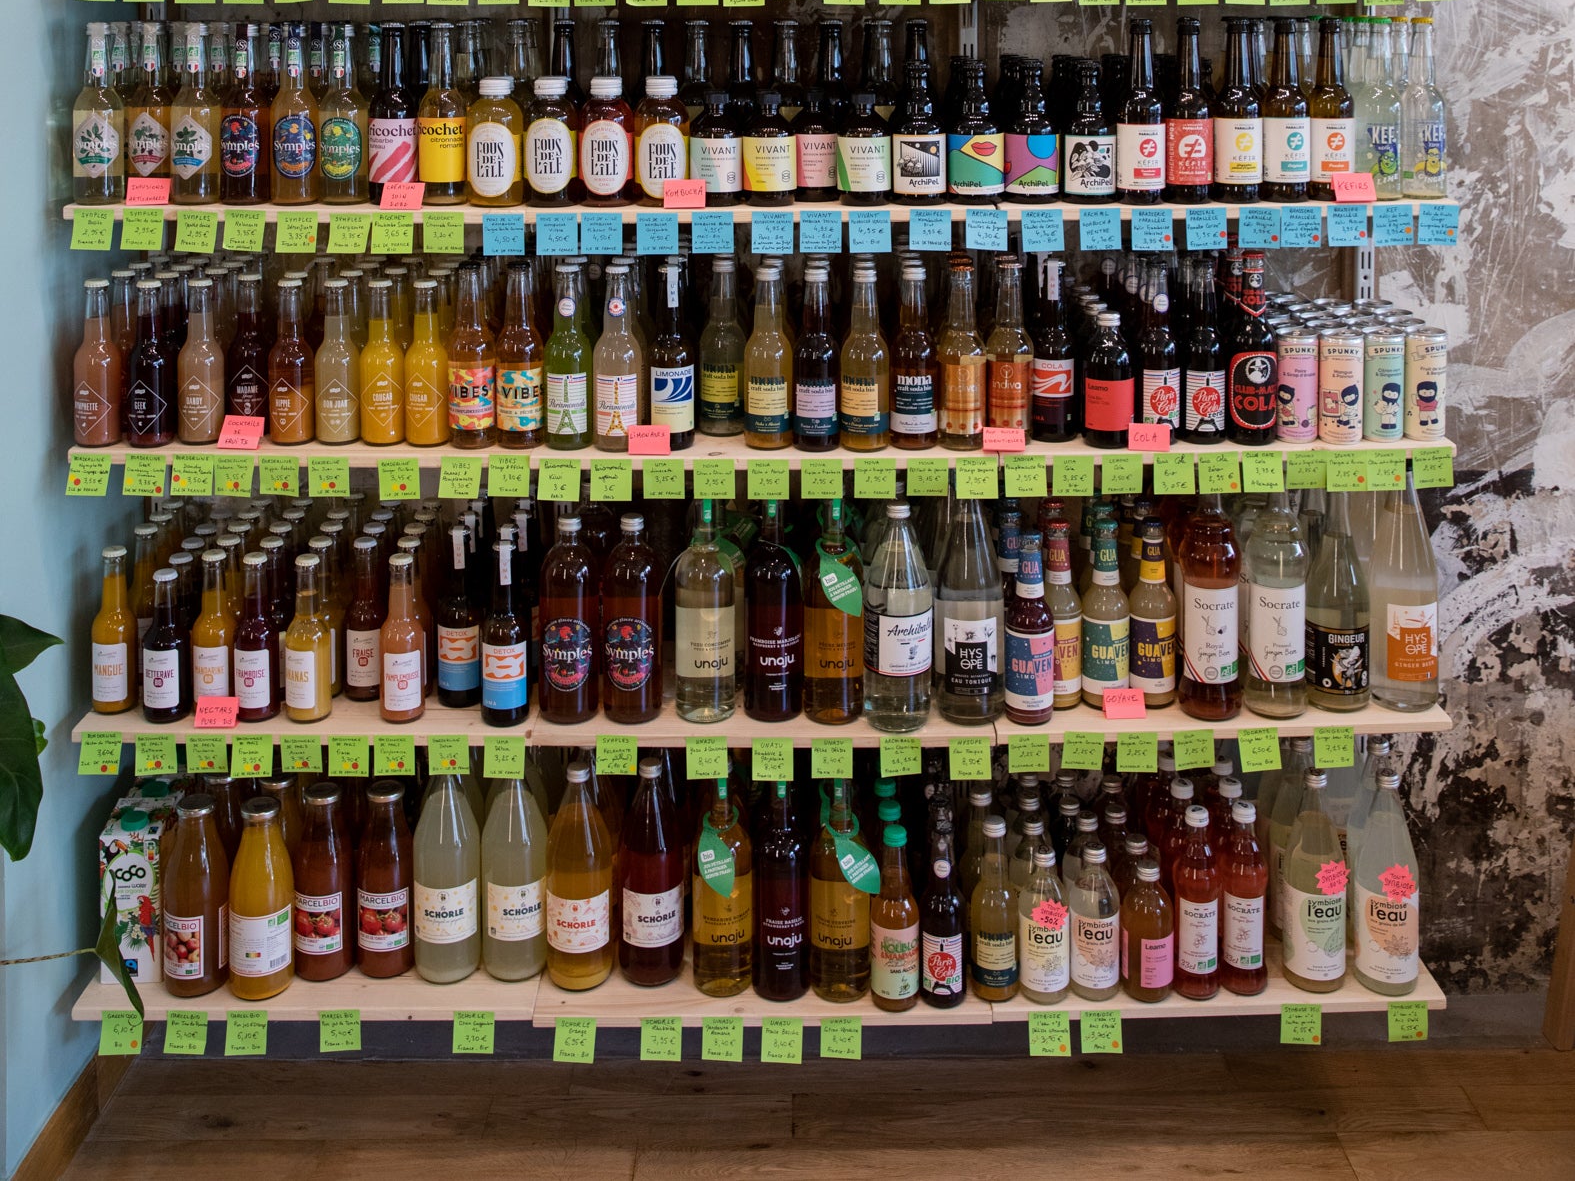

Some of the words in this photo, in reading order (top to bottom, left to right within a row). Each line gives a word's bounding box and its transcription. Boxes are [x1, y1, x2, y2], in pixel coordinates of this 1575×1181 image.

[220, 140, 260, 154] Symples
[274, 139, 316, 152] Symples
[320, 141, 361, 154] Symples
[476, 142, 505, 155] FOUS
[534, 138, 562, 152] FOUS
[590, 139, 619, 153] FOUS
[701, 145, 737, 157] VIVANT
[754, 144, 791, 155] VIVANT
[802, 141, 836, 151] VIVANT
[850, 145, 885, 156] VIVANT
[482, 154, 496, 165] DE
[540, 152, 555, 161] DE
[596, 154, 612, 163] DE
[1283, 346, 1316, 354] SPUNKY
[1327, 347, 1360, 355] SPUNKY
[1373, 346, 1404, 354] SPUNKY
[1041, 362, 1063, 370] COLA
[897, 374, 932, 386] mona
[992, 380, 1022, 390] indiva
[236, 385, 259, 394] MADAME
[1088, 383, 1108, 391] Leamo
[373, 392, 393, 401] COUGAR
[409, 393, 428, 401] COUGAR
[1152, 390, 1176, 404] Paris
[1194, 387, 1218, 403] Paris
[134, 401, 147, 411] GEEK
[186, 397, 203, 406] DANDY
[275, 400, 291, 408] HIPPIE
[1157, 400, 1176, 415] Cola
[1199, 400, 1220, 413] Cola
[1234, 395, 1277, 411] COLA
[1133, 431, 1157, 444] COLA
[1100, 549, 1118, 562] GUA
[1146, 545, 1162, 557] GUA
[1194, 598, 1235, 610] Socrate
[1259, 596, 1301, 609] Socrate
[446, 629, 468, 637] DETOX
[1328, 633, 1365, 643] GINGEUR
[1405, 632, 1428, 644] HYS
[493, 647, 516, 655] DETOX
[1205, 642, 1224, 650] Royal
[352, 648, 375, 659] FRAISE
[542, 642, 593, 664] Symples
[605, 642, 654, 664] Symples
[960, 648, 983, 658] HYS
[694, 656, 728, 670] unaju
[759, 654, 796, 668] unaju
[819, 658, 854, 670] unaju
[94, 662, 123, 676] MANGUE
[1105, 694, 1139, 703] GOYAVE
[199, 706, 233, 714] NECTARS
[424, 908, 464, 919] SCHORLE
[503, 902, 541, 916] SCHORLE
[1184, 909, 1217, 919] SOCRATE
[1228, 904, 1261, 914] SOCRATE
[1307, 903, 1342, 919] l'eau
[638, 911, 676, 923] SCHORLE
[556, 920, 596, 929] SCHORLE
[711, 930, 745, 944] unaju
[1078, 924, 1114, 939] l'eau
[767, 934, 803, 947] unaju
[818, 933, 853, 947] unaju
[1145, 943, 1167, 952] Leamo
[928, 955, 953, 969] Paris
[934, 967, 955, 979] Cola
[946, 975, 961, 984] BIO
